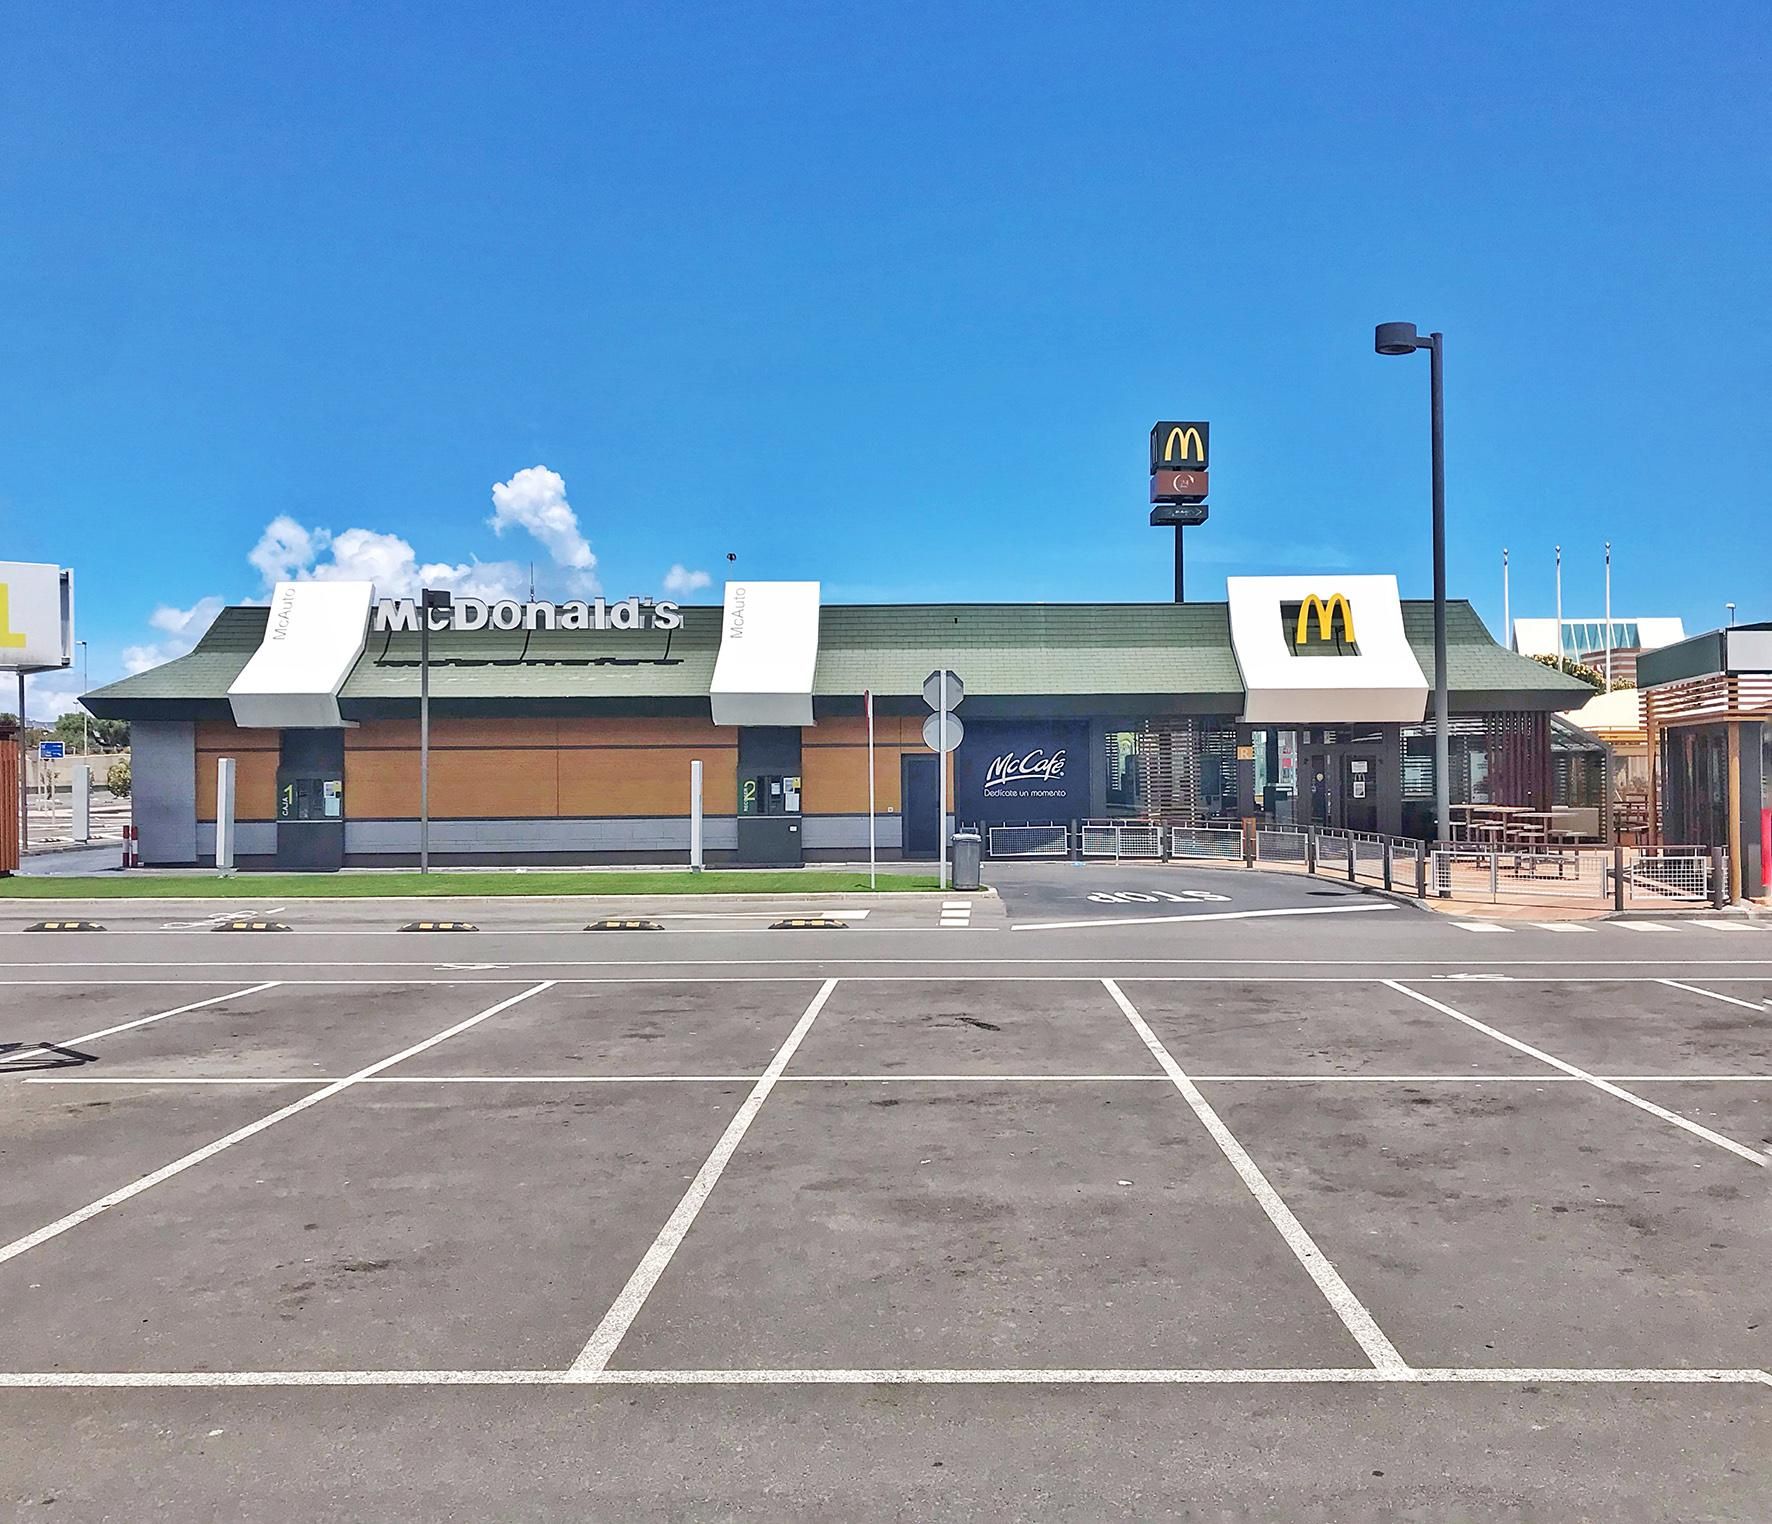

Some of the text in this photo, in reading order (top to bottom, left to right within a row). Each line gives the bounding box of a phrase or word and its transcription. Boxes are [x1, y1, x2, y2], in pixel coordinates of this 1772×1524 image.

[272, 588, 297, 640] McAuto
[376, 597, 681, 632] McDonald's
[729, 587, 747, 639] McAuto
[985, 749, 1066, 791] McCafé
[281, 796, 289, 817] CAJA
[743, 780, 756, 801] 2
[1087, 889, 1233, 904] STOP
